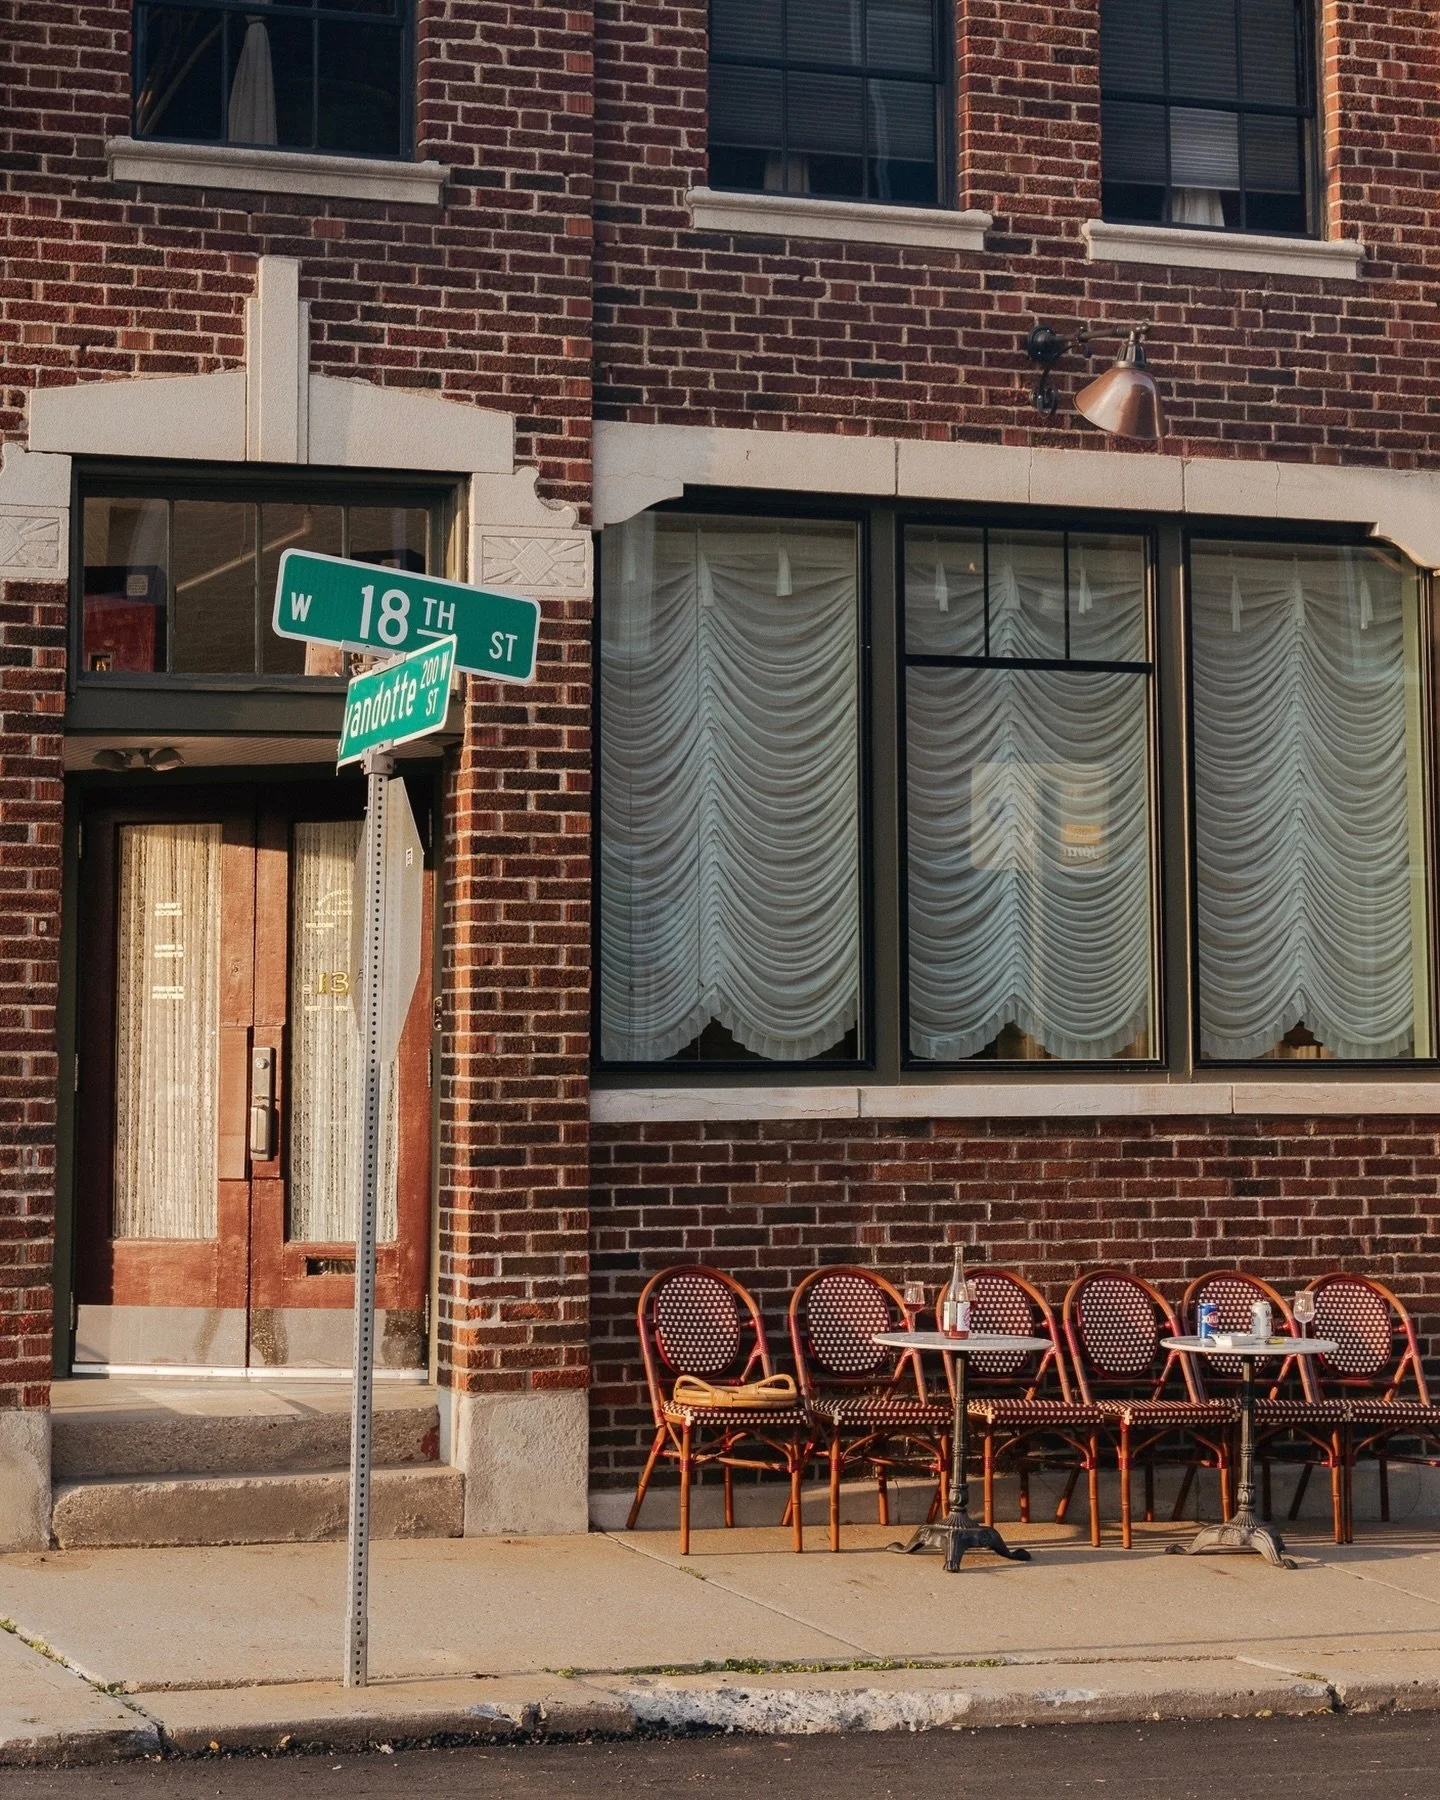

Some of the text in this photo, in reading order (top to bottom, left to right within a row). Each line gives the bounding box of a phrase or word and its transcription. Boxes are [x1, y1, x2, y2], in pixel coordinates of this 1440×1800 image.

[290, 591, 312, 622] W
[488, 631, 518, 662] ST
[420, 650, 450, 689] 200 W
[341, 670, 417, 755] yandotte
[426, 687, 439, 716] ST
[318, 971, 350, 994] 13
